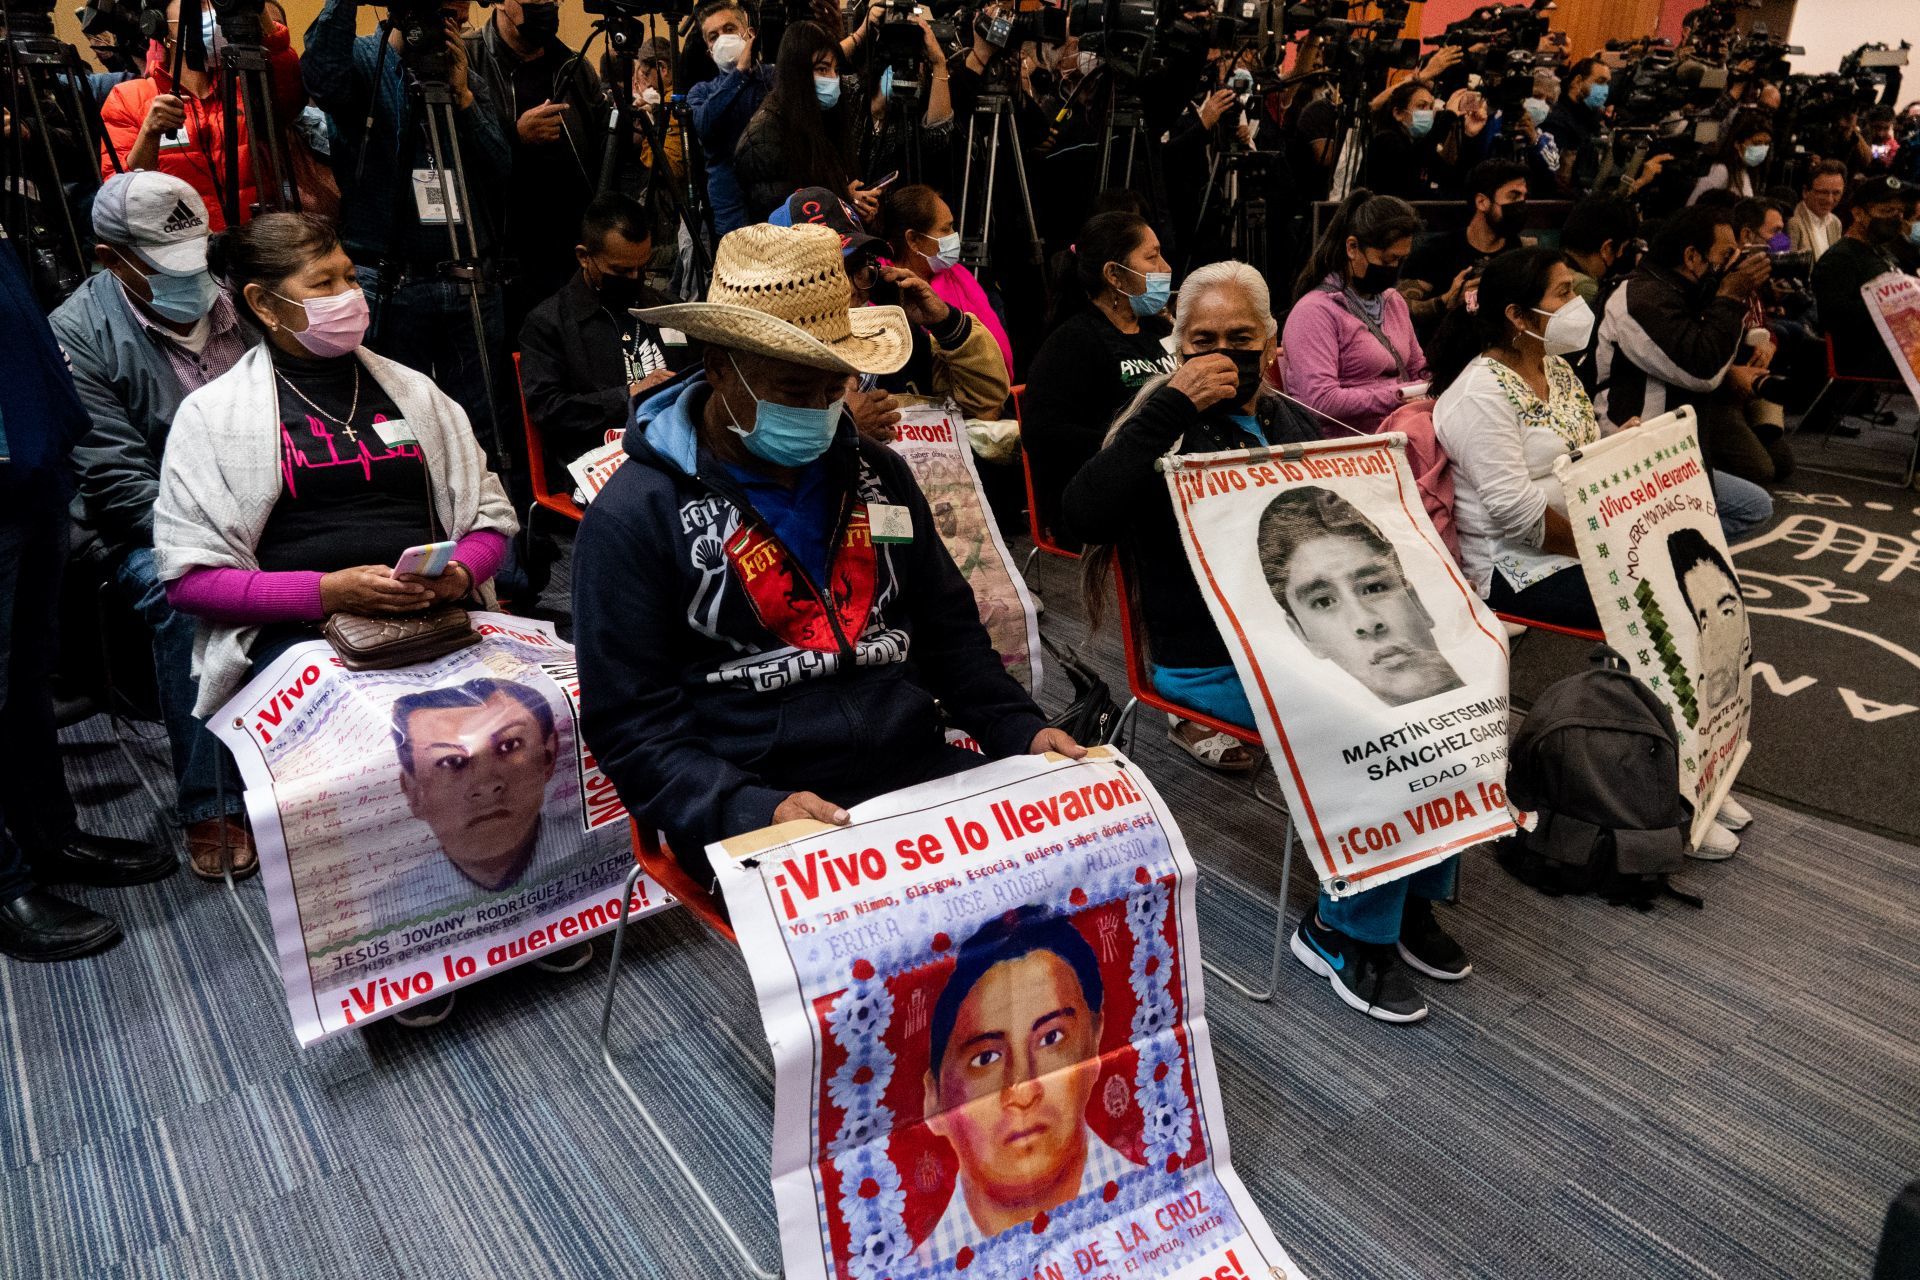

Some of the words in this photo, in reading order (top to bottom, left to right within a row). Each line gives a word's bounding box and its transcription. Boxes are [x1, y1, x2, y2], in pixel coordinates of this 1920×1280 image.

[163, 217, 203, 233] adidas
[1247, 466, 1279, 487] se
[1273, 461, 1304, 482] lo
[1300, 449, 1391, 479] llevaron!
[1599, 495, 1632, 528] ¡Vivo
[1630, 488, 1647, 506] se
[1640, 480, 1657, 501] lo
[1652, 456, 1700, 493] llevaron!
[255, 665, 320, 744] ¡Vivo
[1342, 720, 1430, 765] MARTÍN
[1367, 731, 1473, 781] SÁNCHEZ
[1408, 763, 1467, 792] EDAD
[1472, 753, 1490, 768] 20
[774, 848, 888, 921] ¡Vivo
[895, 834, 945, 871] se
[944, 816, 990, 856] lo
[989, 770, 1142, 842] llevaron!
[1338, 822, 1401, 865] ¡Con
[1403, 790, 1478, 836] VIDA
[1477, 781, 1507, 814] lo
[789, 922, 816, 936] Yo,
[824, 910, 849, 925] Jan
[854, 896, 901, 916] Nimmo,
[905, 876, 962, 899] Glasgow,
[966, 858, 1021, 881] Escocia,
[1025, 843, 1064, 864] quiero
[1067, 831, 1098, 849] saber
[333, 939, 390, 971] JESÚS
[402, 915, 466, 947] JOVANY
[476, 880, 565, 923] RODRÍGUEZ
[825, 917, 904, 960] ERIKA
[341, 971, 434, 1025] ¡Vivo
[442, 954, 477, 983] lo
[1072, 1240, 1109, 1275] DE
[1115, 1221, 1150, 1254] LA
[1155, 1189, 1211, 1232] CRUZ
[1124, 1258, 1140, 1274] El
[1187, 1214, 1223, 1239] Tixtla
